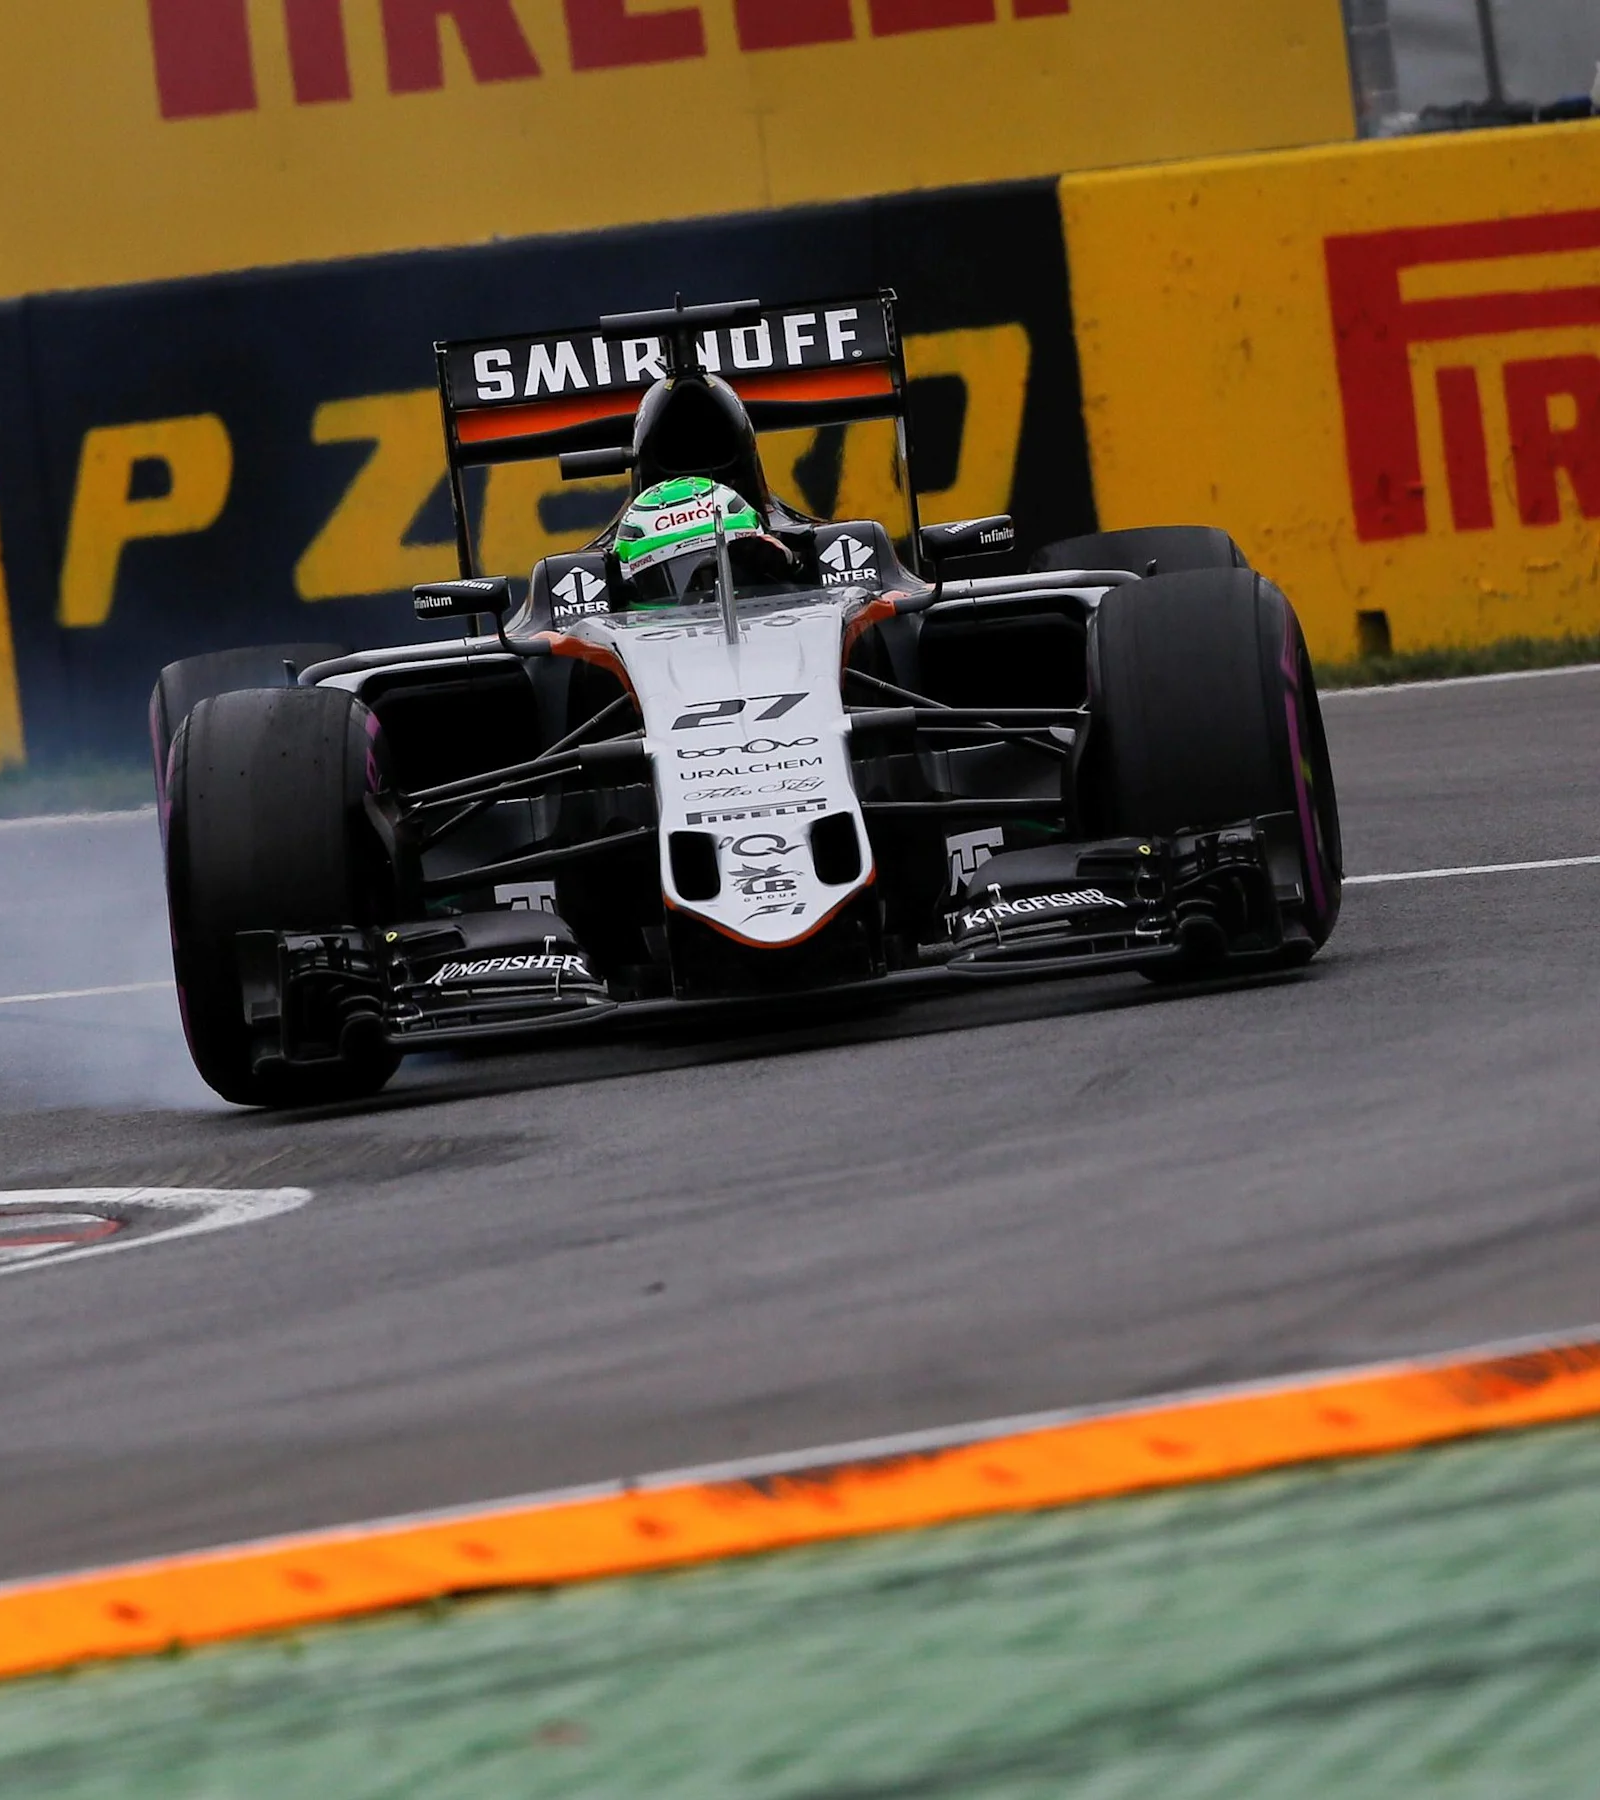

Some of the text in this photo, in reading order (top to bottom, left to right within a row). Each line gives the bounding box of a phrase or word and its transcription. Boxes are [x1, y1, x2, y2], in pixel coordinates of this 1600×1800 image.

[58, 412, 233, 628] P
[821, 567, 878, 586] INTER
[554, 600, 610, 618] INTER
[671, 692, 810, 730] 27
[680, 757, 823, 780] URALCHEM
[685, 797, 828, 826] PIRELLI
[743, 892, 798, 903] GROUP
[962, 888, 1127, 930] KINGFISHER
[424, 954, 590, 987] KINGFISHER
